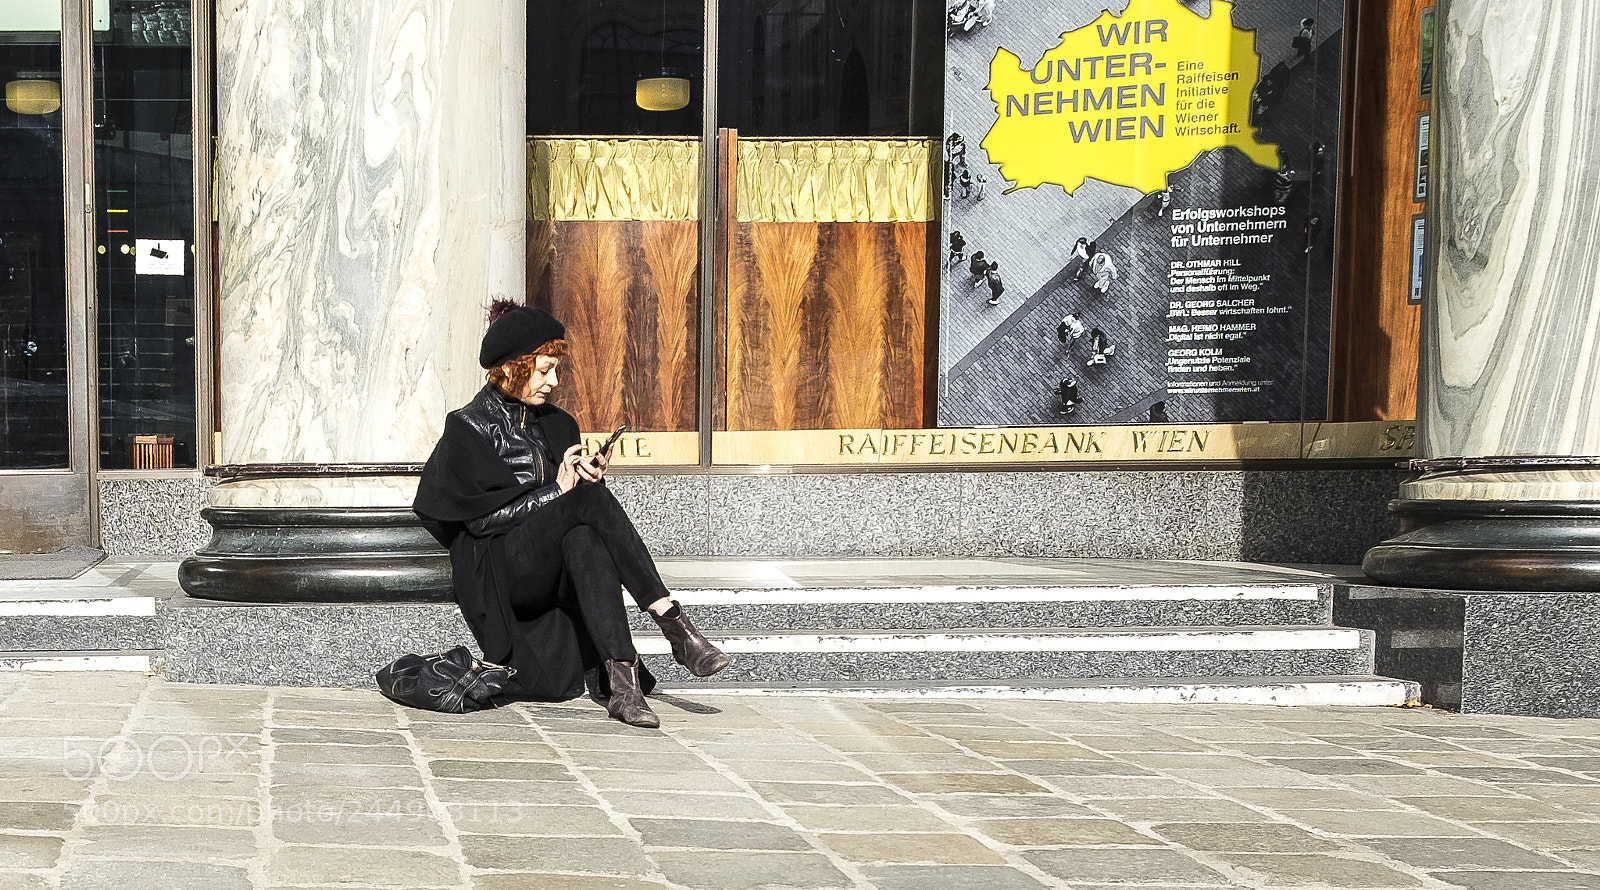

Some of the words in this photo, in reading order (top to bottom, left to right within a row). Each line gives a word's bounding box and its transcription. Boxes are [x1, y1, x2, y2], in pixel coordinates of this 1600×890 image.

[1096, 19, 1169, 47] WIR
[1029, 52, 1167, 85] UNTER-
[1177, 60, 1204, 71] Eine
[1176, 70, 1239, 85] Raiffeisen
[1176, 85, 1229, 98] Initiative
[1006, 82, 1166, 118] NEHMEN
[1175, 99, 1194, 111] für
[1196, 98, 1215, 110] die
[1175, 112, 1219, 124] Wiener
[1068, 114, 1165, 143] WIEN
[1175, 123, 1241, 137] Wirtschaft.
[1172, 205, 1286, 221] Erfolgsworkshops
[1171, 224, 1194, 234] von
[1197, 219, 1287, 233] Unternehmern
[1171, 236, 1189, 247] für
[1191, 233, 1273, 247] Unternehmer
[1170, 261, 1185, 269] DR.
[1186, 260, 1221, 268] OTHMAR
[1170, 277, 1184, 285] Der
[1185, 276, 1216, 284] Mensch
[1170, 285, 1185, 293] und
[1170, 301, 1183, 309] DR.
[1185, 300, 1215, 309] GEORG
[1216, 299, 1255, 307] SALCHER
[1191, 308, 1218, 316] Besser
[1219, 307, 1265, 315] wirtschaften
[1169, 325, 1190, 333] MAG.
[1220, 323, 1256, 331] HAMMER
[1193, 332, 1204, 340] ist
[1205, 331, 1223, 340] nicht
[1167, 349, 1197, 357] GEORG
[1199, 348, 1222, 356] KOLM
[1212, 356, 1251, 364] Potenziale
[1167, 365, 1191, 373] finden
[838, 429, 1106, 456] RAIFFEISENBANK
[1131, 429, 1211, 453] WIEN
